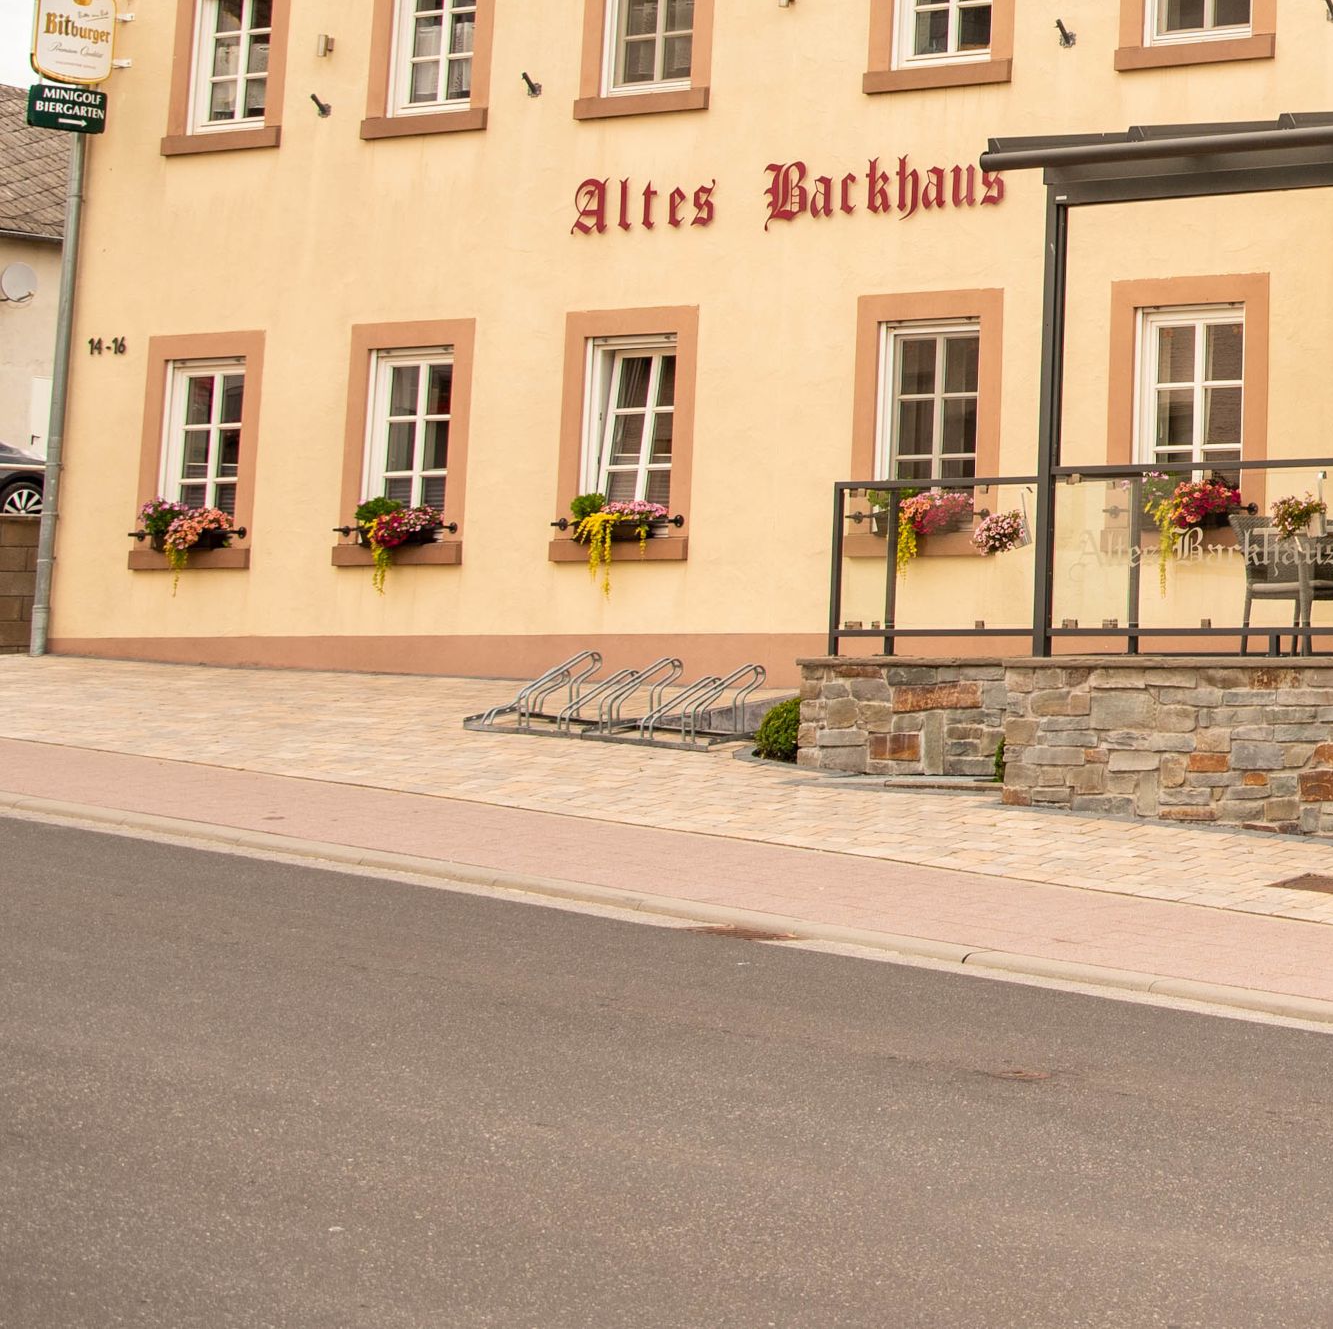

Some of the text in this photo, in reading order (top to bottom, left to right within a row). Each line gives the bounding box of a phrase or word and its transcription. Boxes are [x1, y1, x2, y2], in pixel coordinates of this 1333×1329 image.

[43, 12, 111, 44] Bitburger
[35, 100, 105, 120] BIERGARTEN
[43, 87, 102, 105] MINIGOLF
[570, 155, 1006, 236] Altes Backhaus
[1068, 533, 1159, 582] Altes
